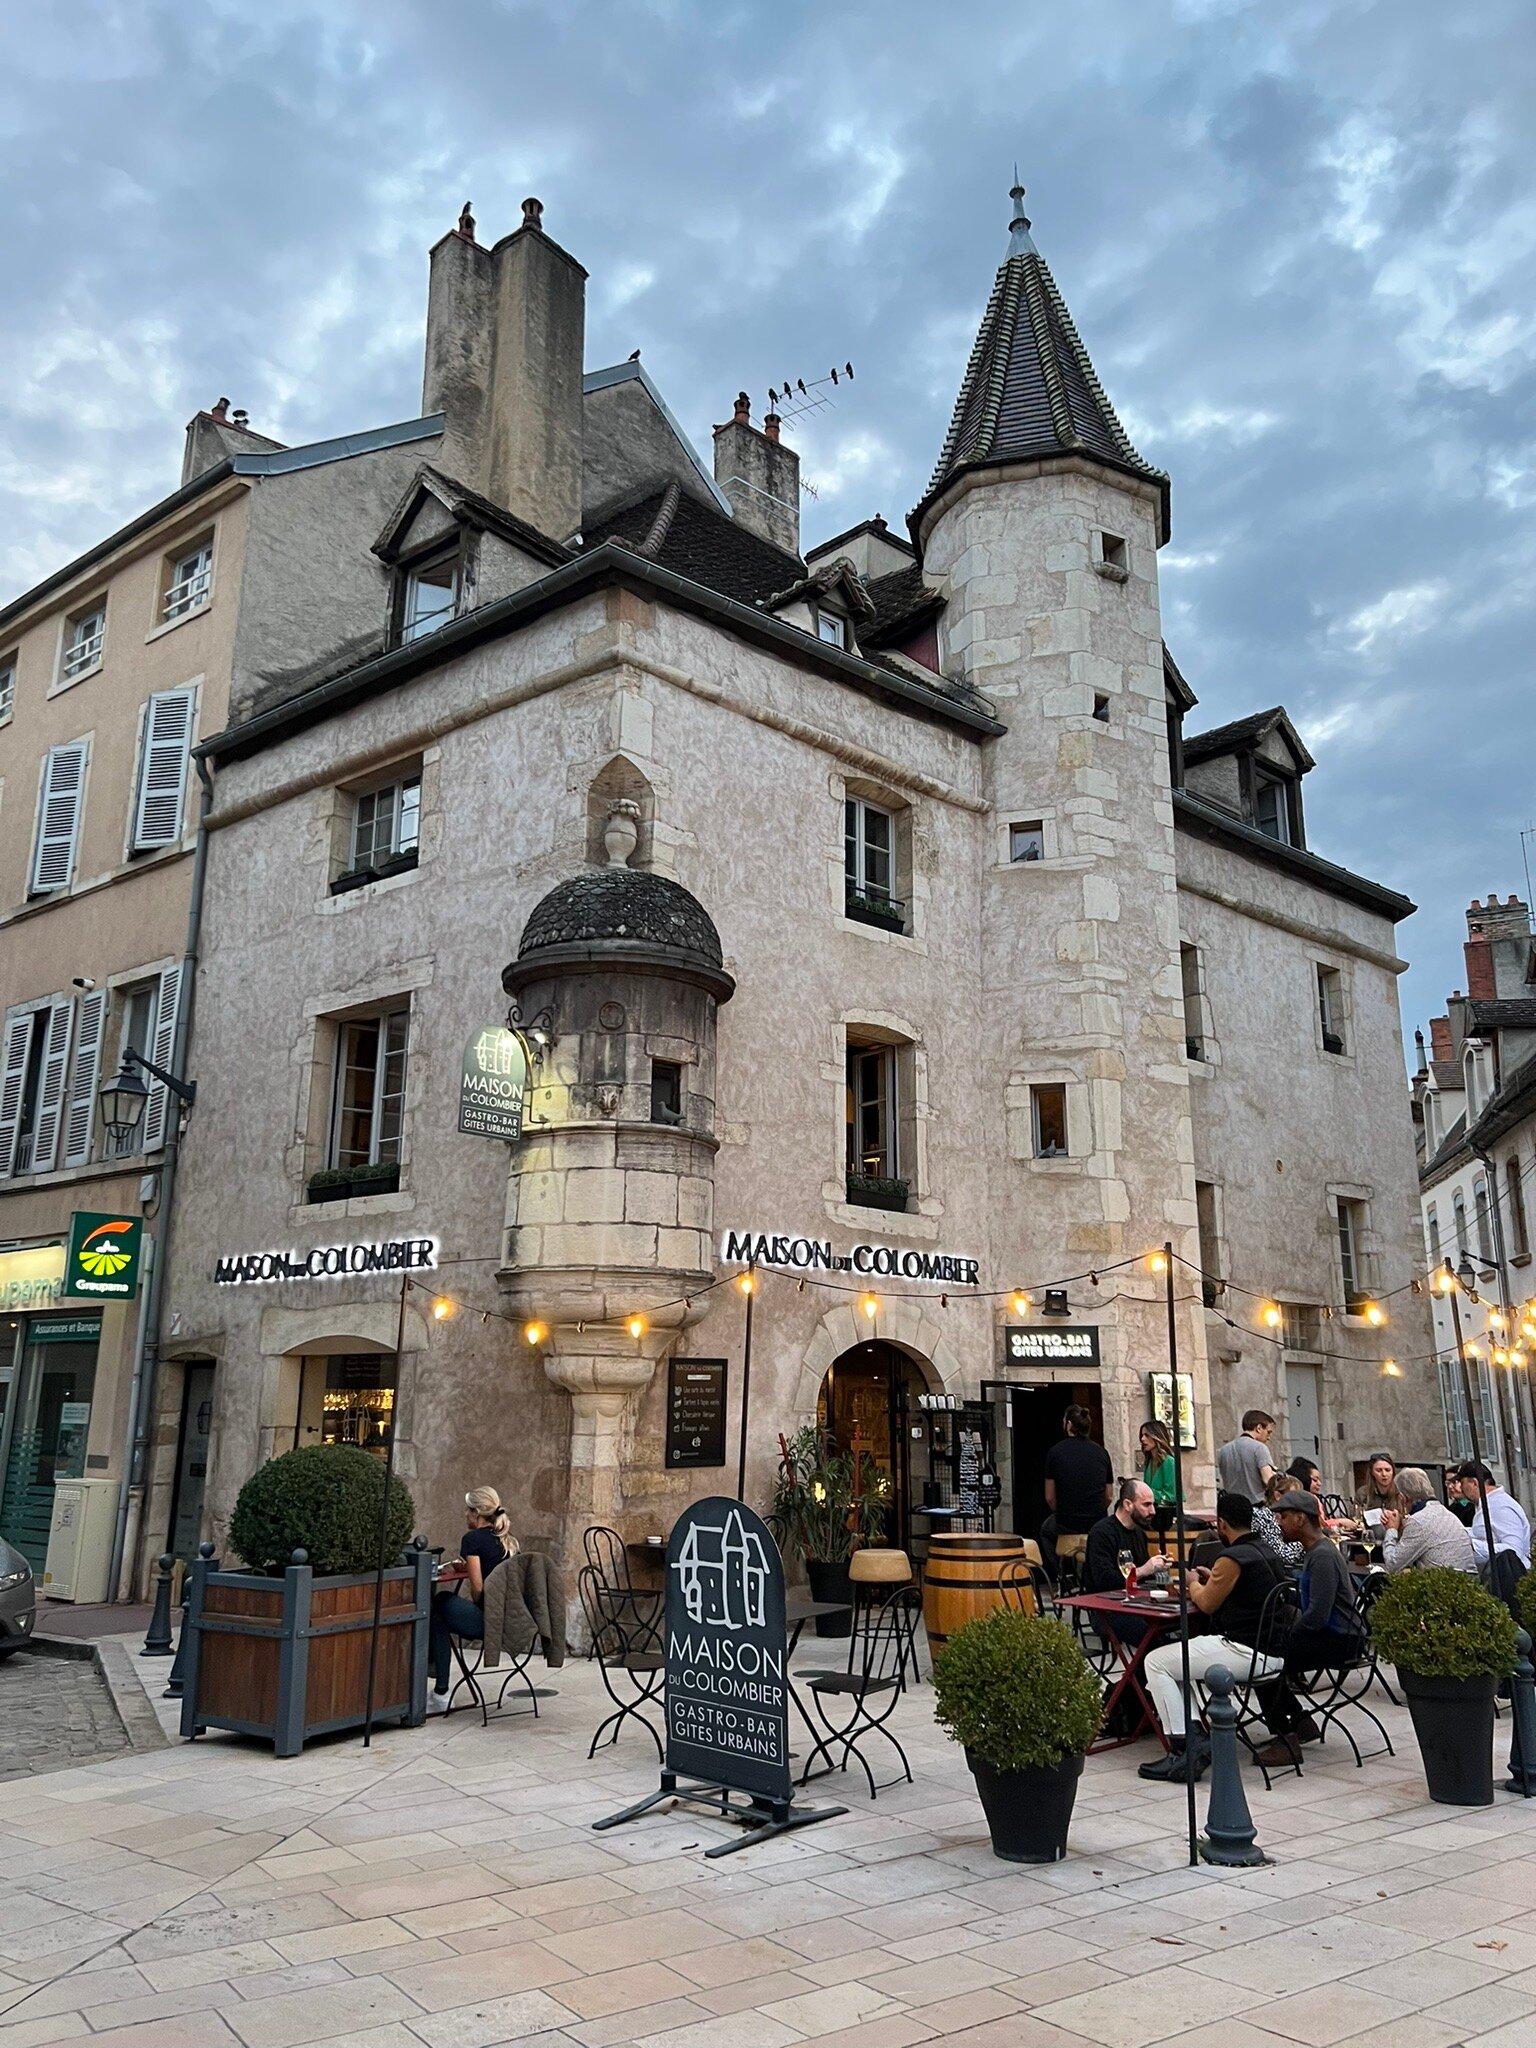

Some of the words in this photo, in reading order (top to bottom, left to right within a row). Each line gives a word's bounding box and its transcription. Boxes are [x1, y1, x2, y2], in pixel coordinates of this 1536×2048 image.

[463, 1072, 524, 1100] MAISON
[470, 1092, 523, 1113] COLOMBIER
[463, 1119, 485, 1131] GITES
[486, 1123, 518, 1137] URBAINS
[214, 1252, 290, 1284] MAISON
[306, 1239, 433, 1277] COLOMBIER
[725, 1231, 832, 1270] MAISON
[853, 1245, 980, 1285] COLOMBIER
[1045, 1346, 1092, 1357] URBAINS
[669, 1631, 782, 1680] MAISON
[669, 1674, 681, 1686] DU
[683, 1670, 782, 1706] COLOMBIER
[676, 1721, 713, 1743] GITES
[717, 1728, 777, 1758] URBAINS
